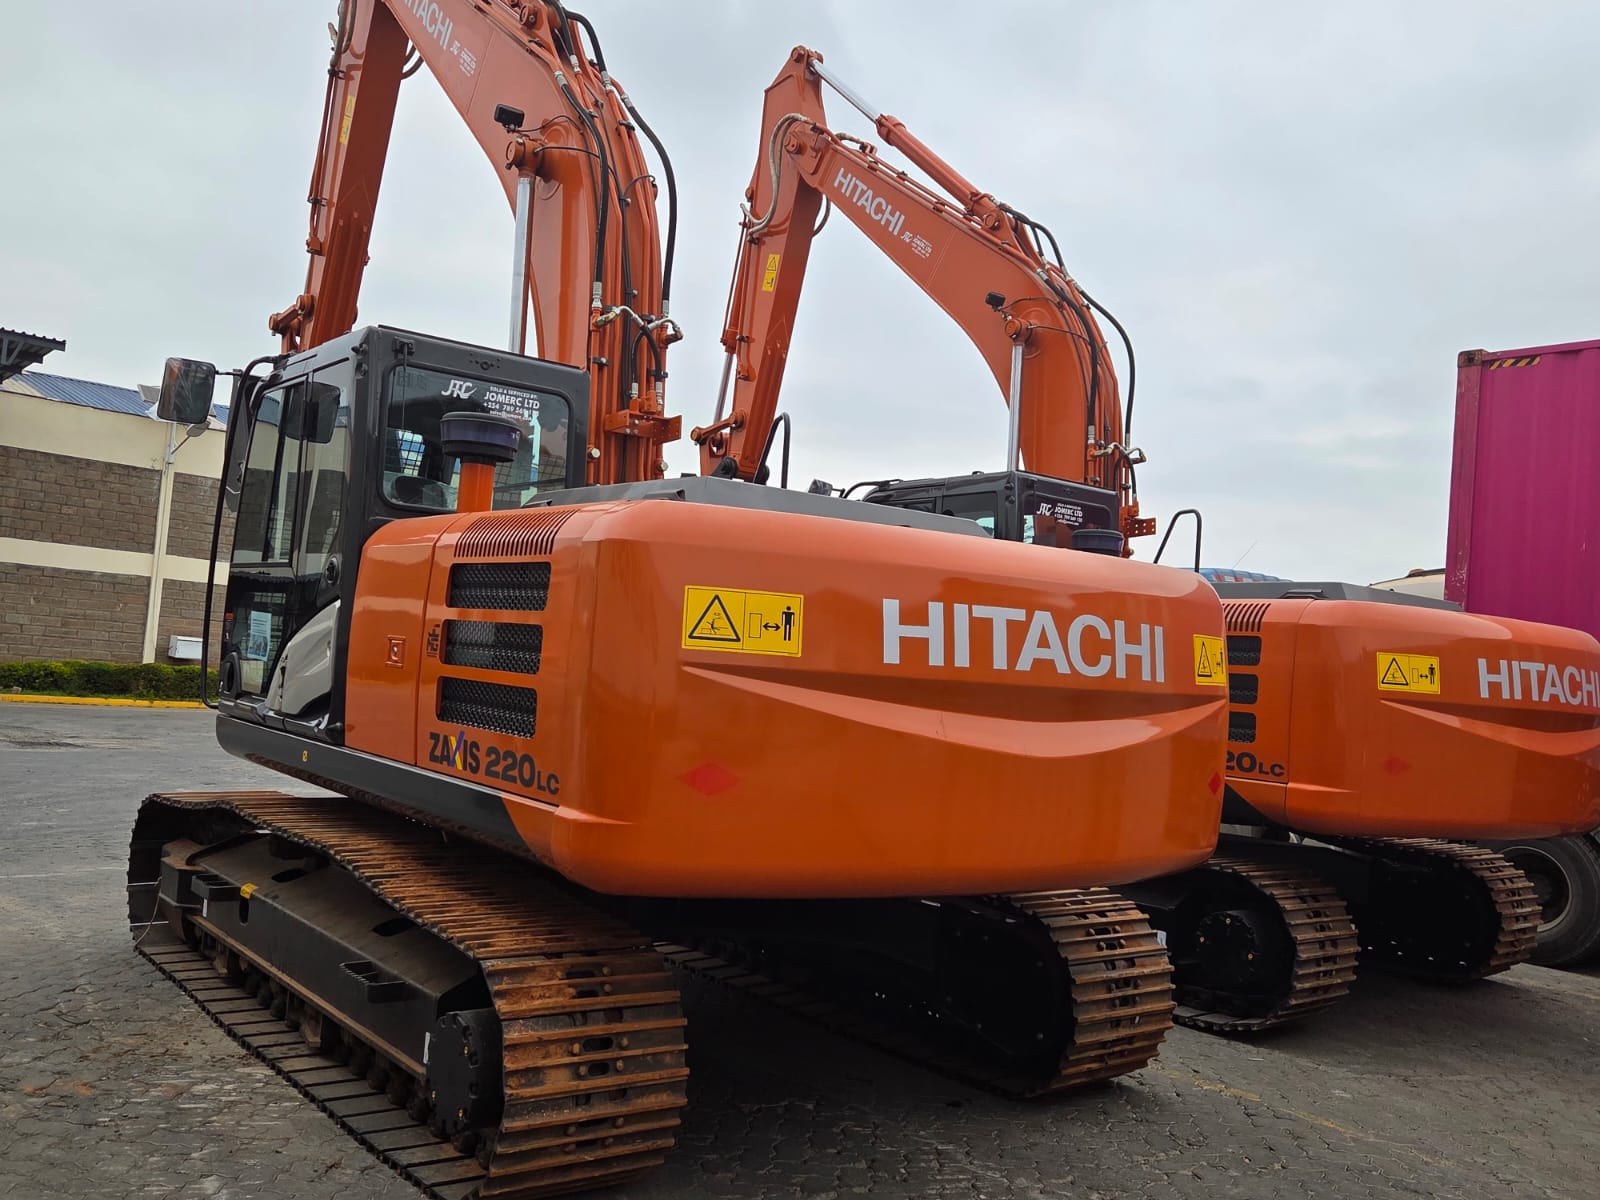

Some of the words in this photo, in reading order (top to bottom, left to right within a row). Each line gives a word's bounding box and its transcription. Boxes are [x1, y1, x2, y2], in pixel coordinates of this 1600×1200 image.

[833, 167, 905, 236] HITACHI
[441, 379, 477, 399] JTC
[483, 391, 523, 407] JOMERC
[524, 398, 540, 409] LTD
[483, 401, 500, 410] +254
[1036, 502, 1054, 516] JTC
[882, 598, 1165, 683] HITACHI
[1477, 658, 1600, 708] HITACHI
[429, 731, 480, 774] ZAXIS
